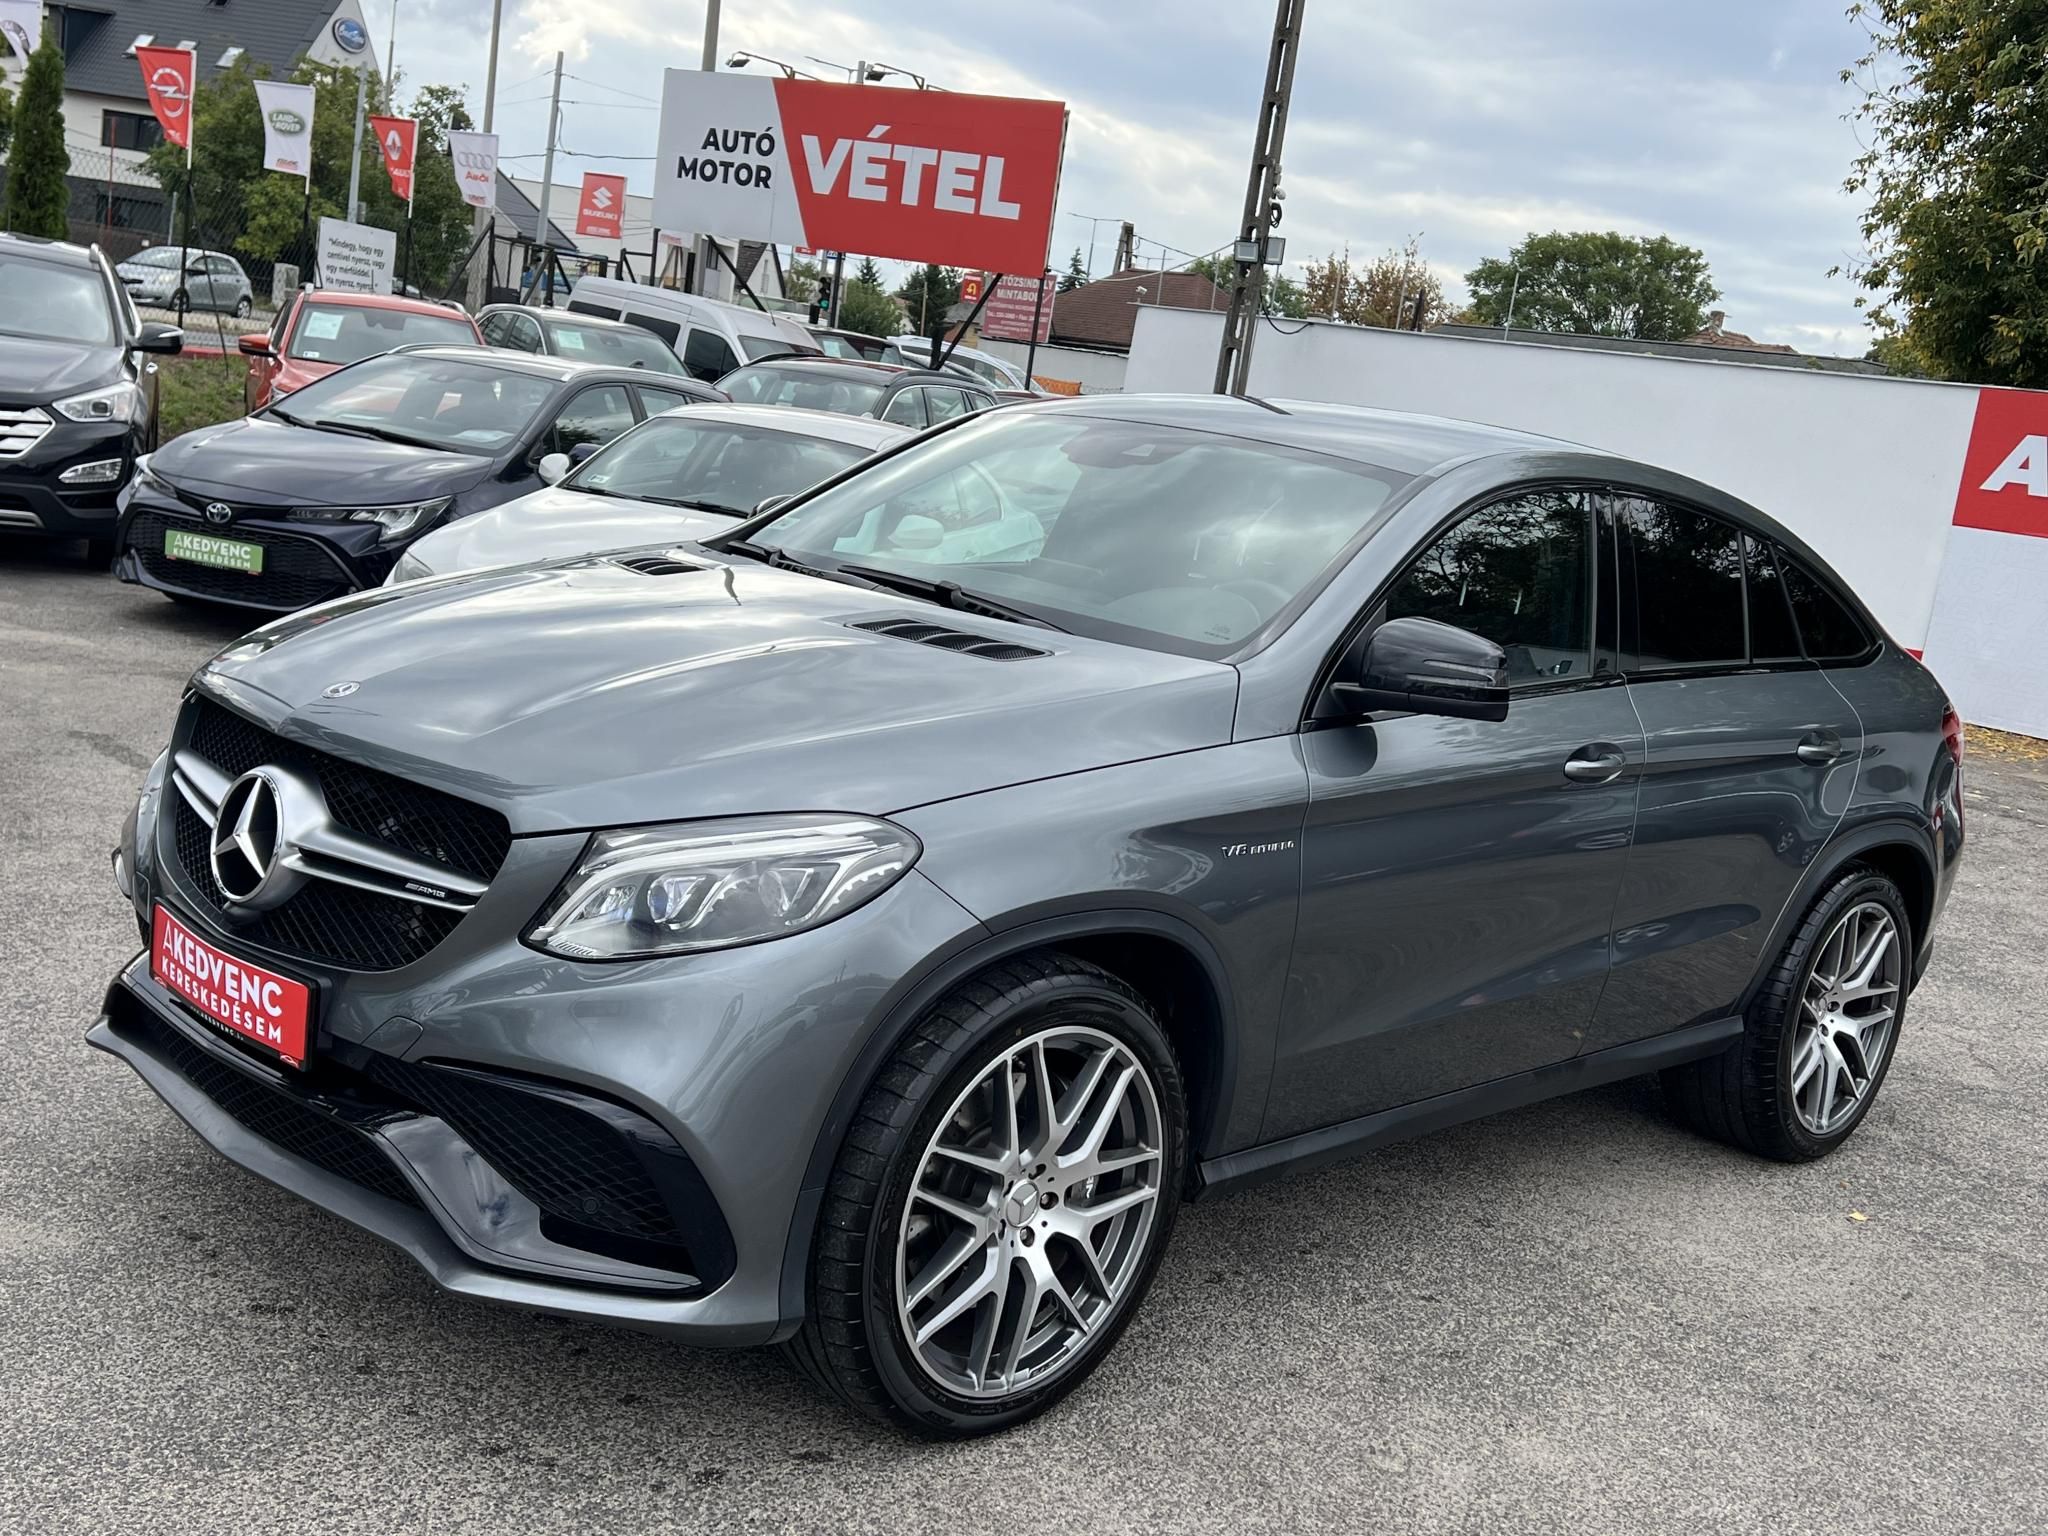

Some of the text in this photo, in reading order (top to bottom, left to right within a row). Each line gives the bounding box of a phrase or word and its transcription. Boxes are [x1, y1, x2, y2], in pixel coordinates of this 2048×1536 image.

[701, 126, 775, 157] AUTÓ
[677, 156, 771, 189] MOTOR
[801, 124, 1021, 220] VÉTEL
[583, 209, 618, 221] SUZUKI
[1979, 433, 2048, 497] A
[173, 534, 251, 559] AKEDVENC
[173, 547, 251, 569] KERESKEDÉSEM
[163, 919, 282, 1017] AKEDVENC
[161, 955, 281, 1044] KERESKEDÉSEM
